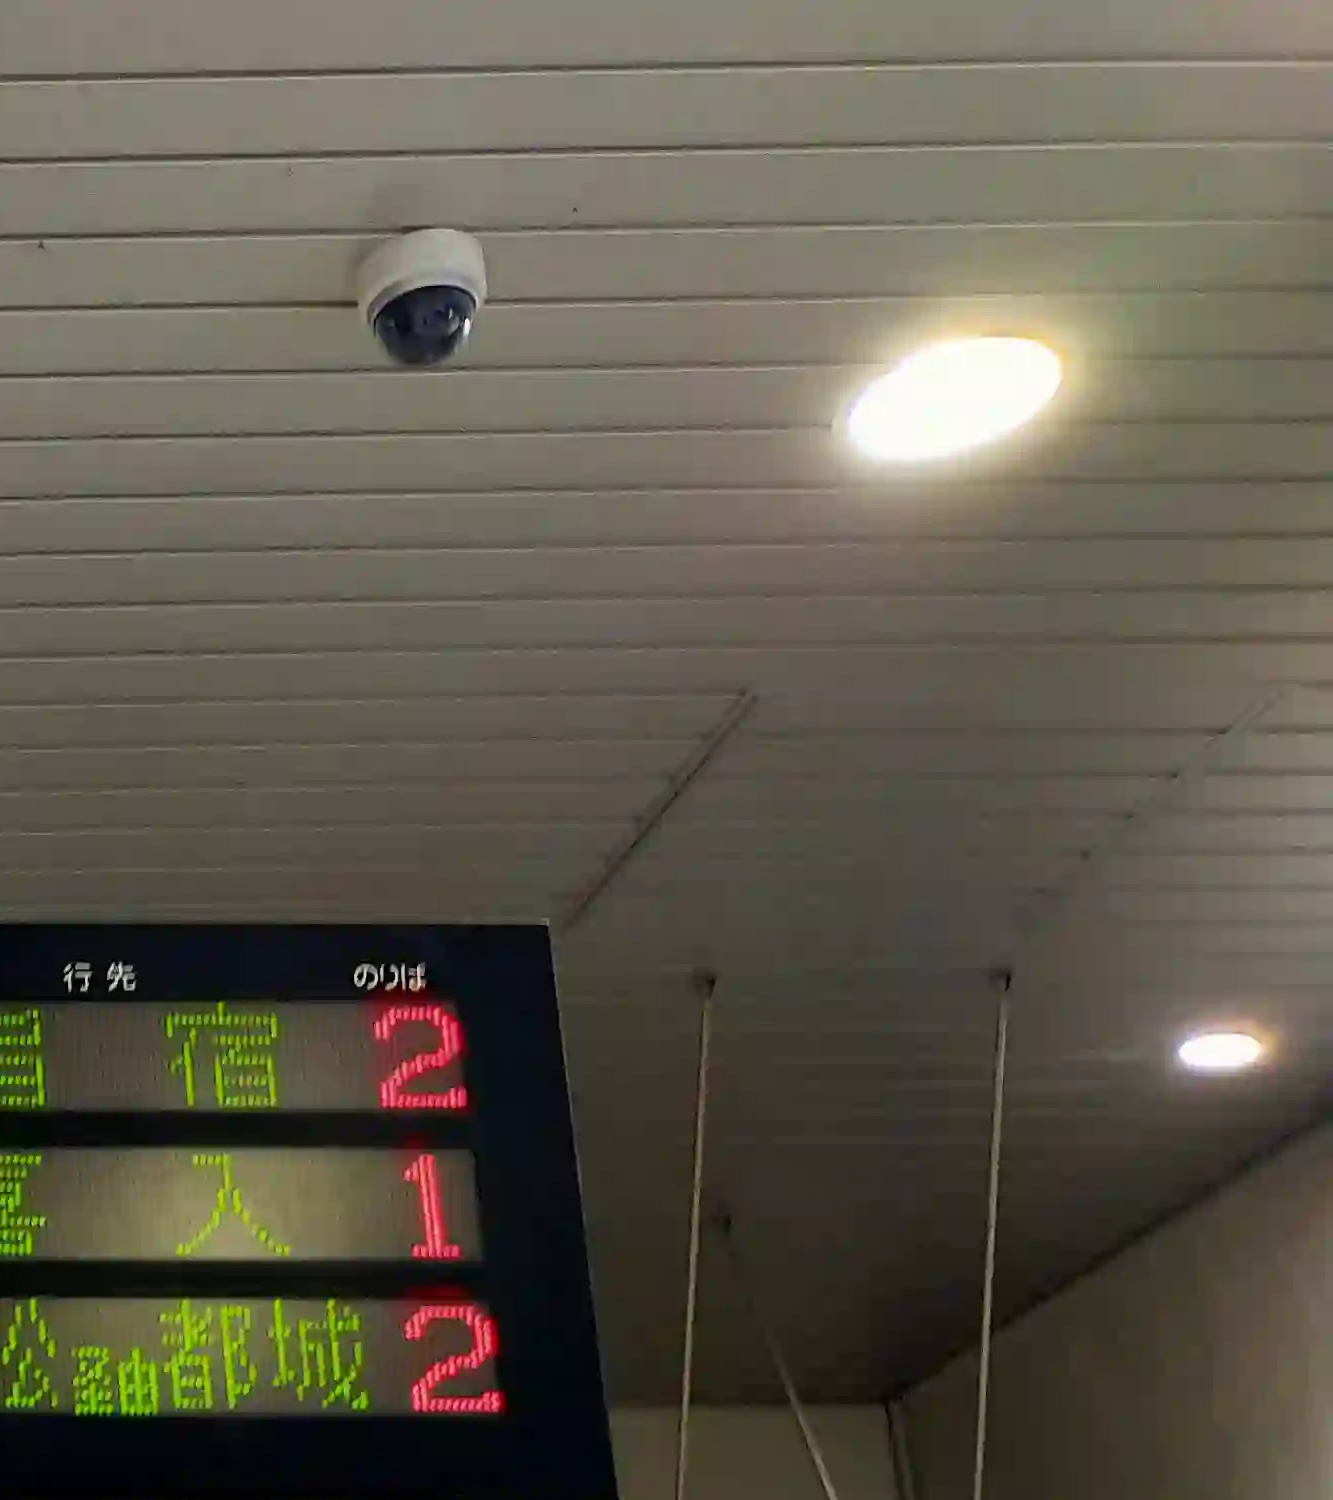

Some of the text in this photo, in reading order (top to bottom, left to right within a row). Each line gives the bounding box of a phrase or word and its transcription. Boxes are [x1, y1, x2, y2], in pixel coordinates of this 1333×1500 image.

[63, 961, 136, 992] 行先
[374, 1004, 468, 1109] 2
[404, 1154, 462, 1258] 1
[403, 1304, 505, 1413] 2
